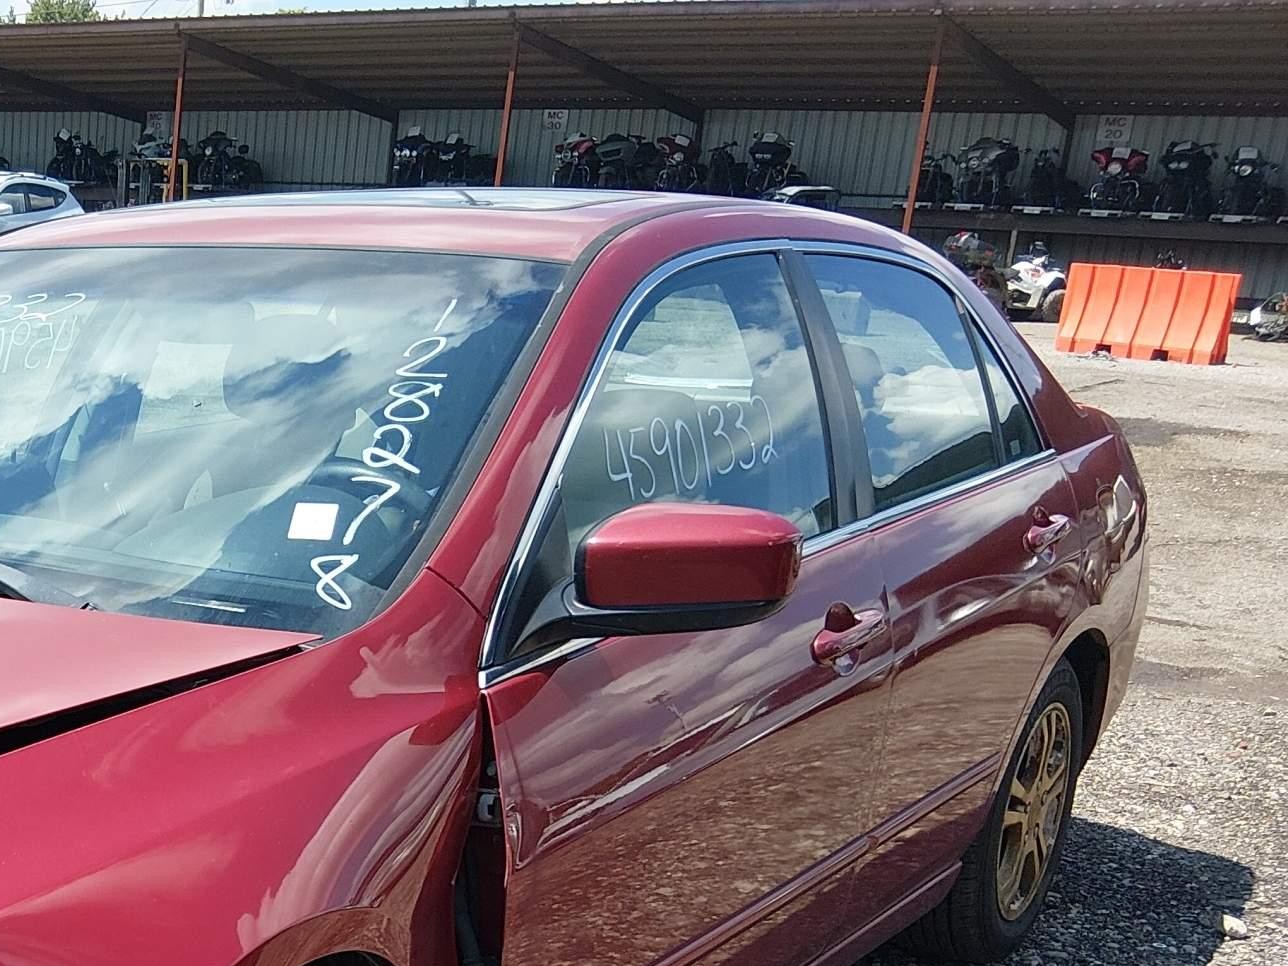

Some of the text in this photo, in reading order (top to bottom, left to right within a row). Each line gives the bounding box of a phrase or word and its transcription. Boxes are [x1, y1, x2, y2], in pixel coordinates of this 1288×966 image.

[547, 111, 565, 120] MC
[1104, 116, 1128, 128] MC
[1104, 129, 1122, 140] 20
[603, 395, 778, 501] 45901332
